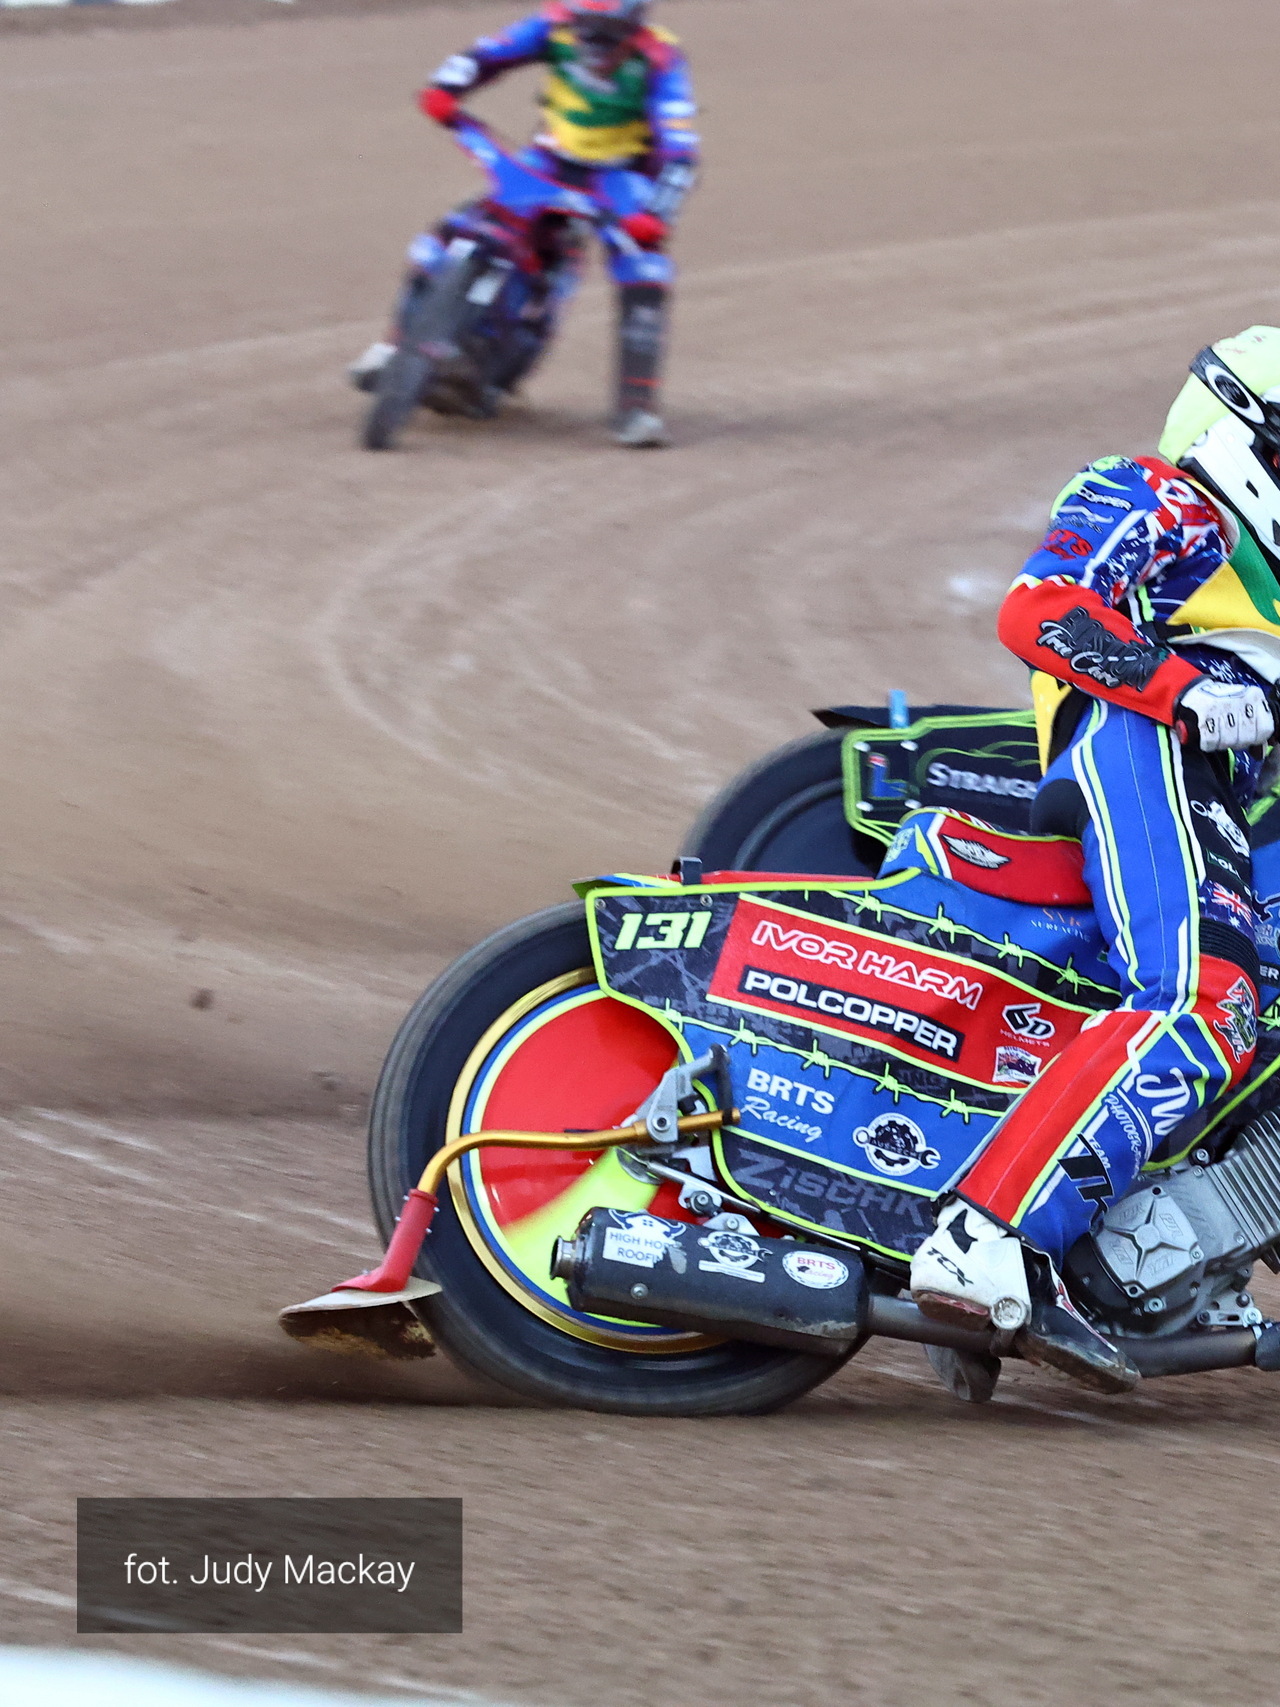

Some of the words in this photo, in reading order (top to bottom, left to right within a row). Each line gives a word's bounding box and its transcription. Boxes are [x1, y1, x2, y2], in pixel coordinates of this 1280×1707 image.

[614, 911, 712, 950] 131
[751, 920, 858, 970] IVOR
[857, 949, 984, 1010] HARM
[744, 969, 958, 1057] POLCOPPER
[746, 1067, 835, 1115] BRTS
[740, 1094, 823, 1143] Racing
[1088, 1135, 1111, 1169] TEAM
[609, 1231, 641, 1246] HIGH
[797, 1256, 836, 1270] BRTS
